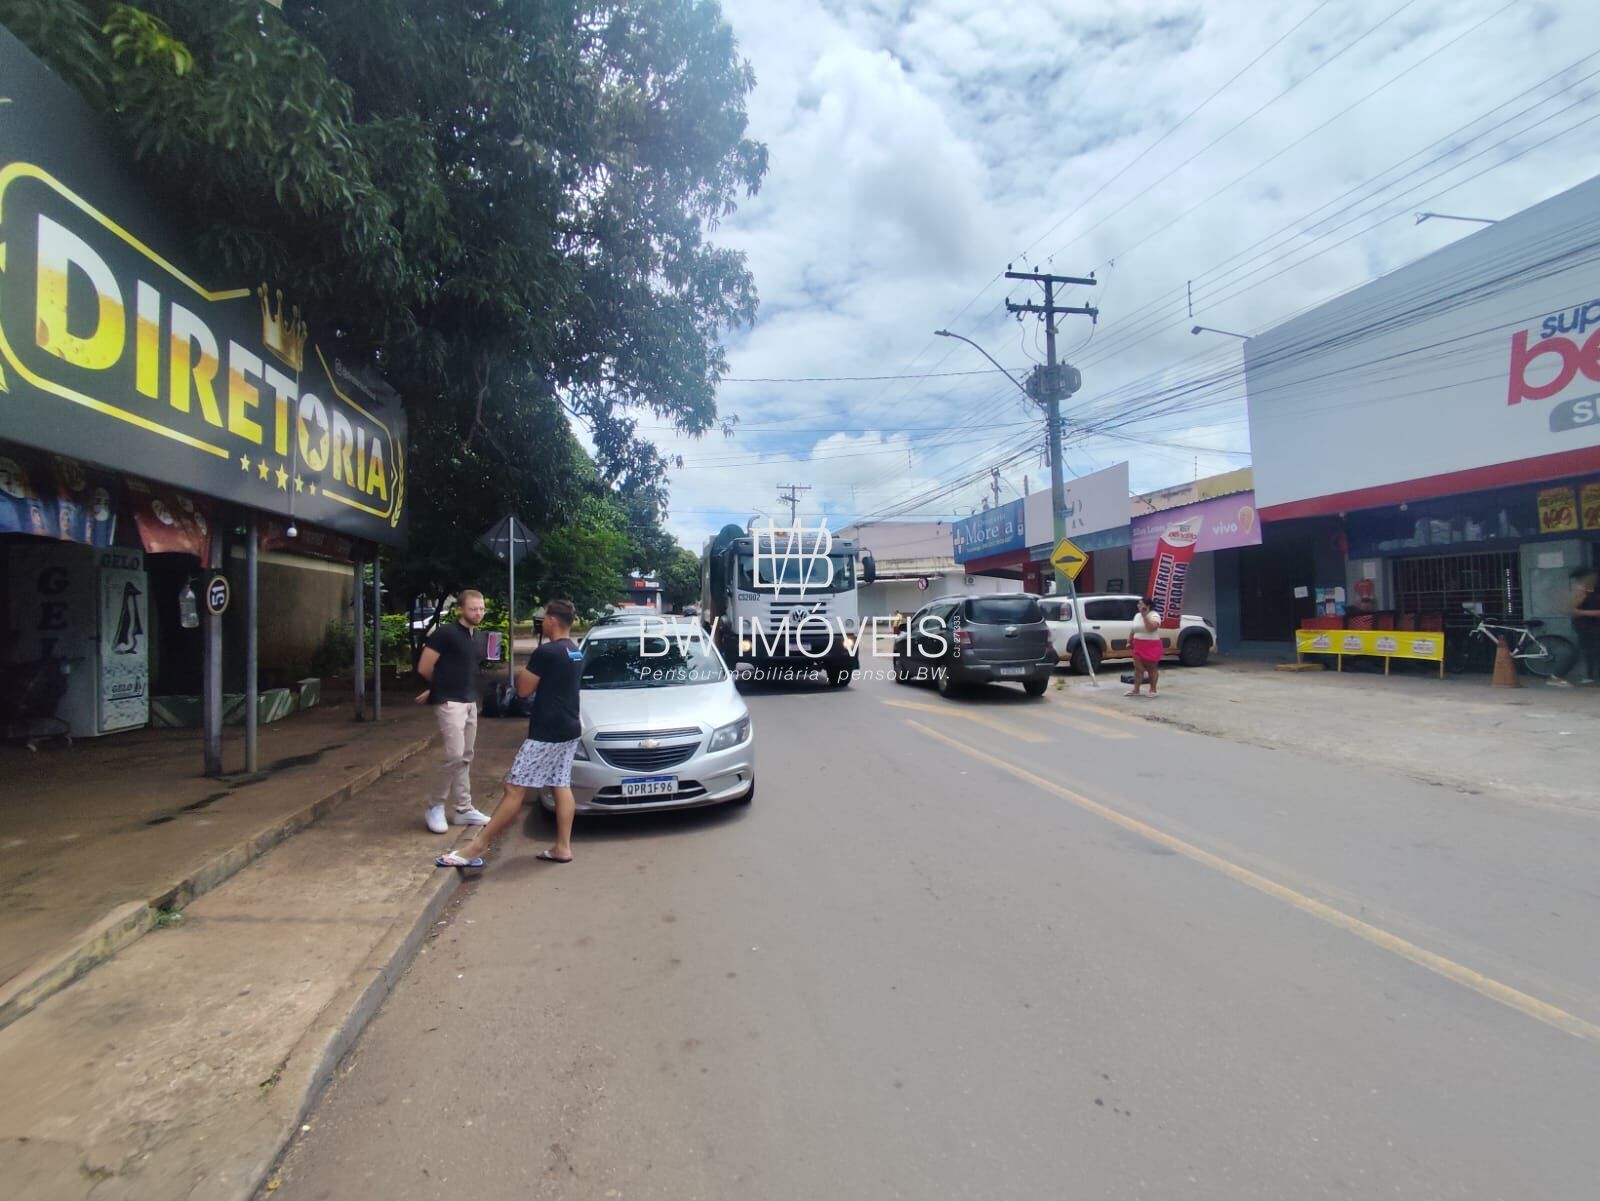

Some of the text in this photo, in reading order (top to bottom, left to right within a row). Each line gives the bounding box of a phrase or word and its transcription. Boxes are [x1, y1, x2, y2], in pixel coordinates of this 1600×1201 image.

[35, 212, 388, 502] DIRETORIA
[1212, 521, 1238, 535] vivo
[100, 553, 138, 570] GELO
[211, 585, 226, 606] 51
[1154, 554, 1173, 621] ORTIFRUTI
[1169, 563, 1187, 611] PADARIA
[627, 782, 673, 795] QPR1F96
